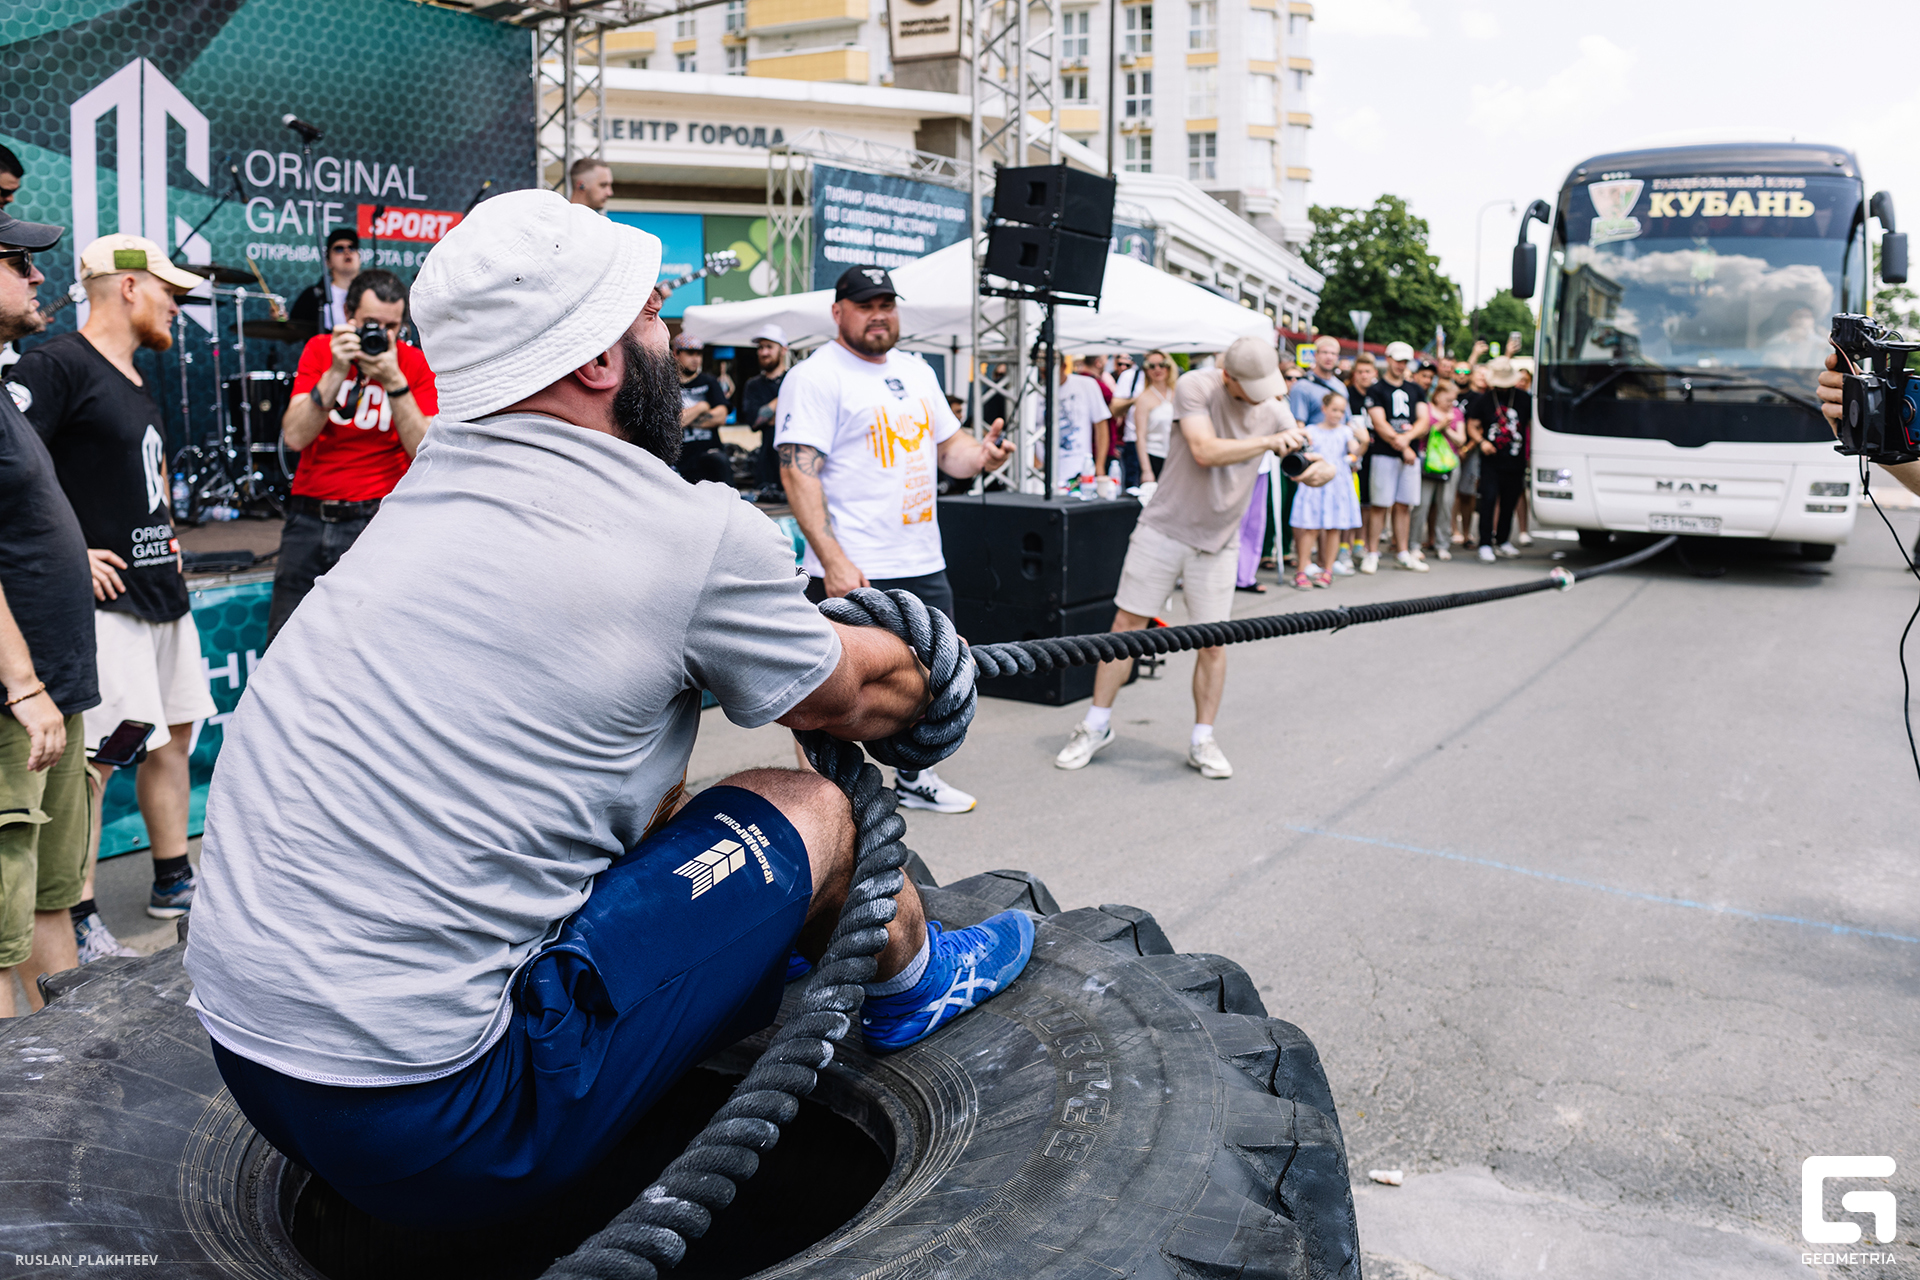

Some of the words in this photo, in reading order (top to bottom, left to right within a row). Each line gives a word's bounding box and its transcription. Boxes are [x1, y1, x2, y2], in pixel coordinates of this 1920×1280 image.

[688, 122, 786, 149] ГОРОДА
[244, 149, 428, 201] ORIGINAL
[1648, 190, 1816, 218] КУБАНЬ
[245, 196, 344, 237] GATE
[368, 211, 453, 240] SPORT
[246, 241, 328, 263] ОТКРЫВА
[1656, 481, 1718, 493] MAN
[132, 540, 169, 559] GATE
[713, 812, 775, 885] КРАСНОДАРСКИЙ
[747, 823, 771, 848] КРАЙ
